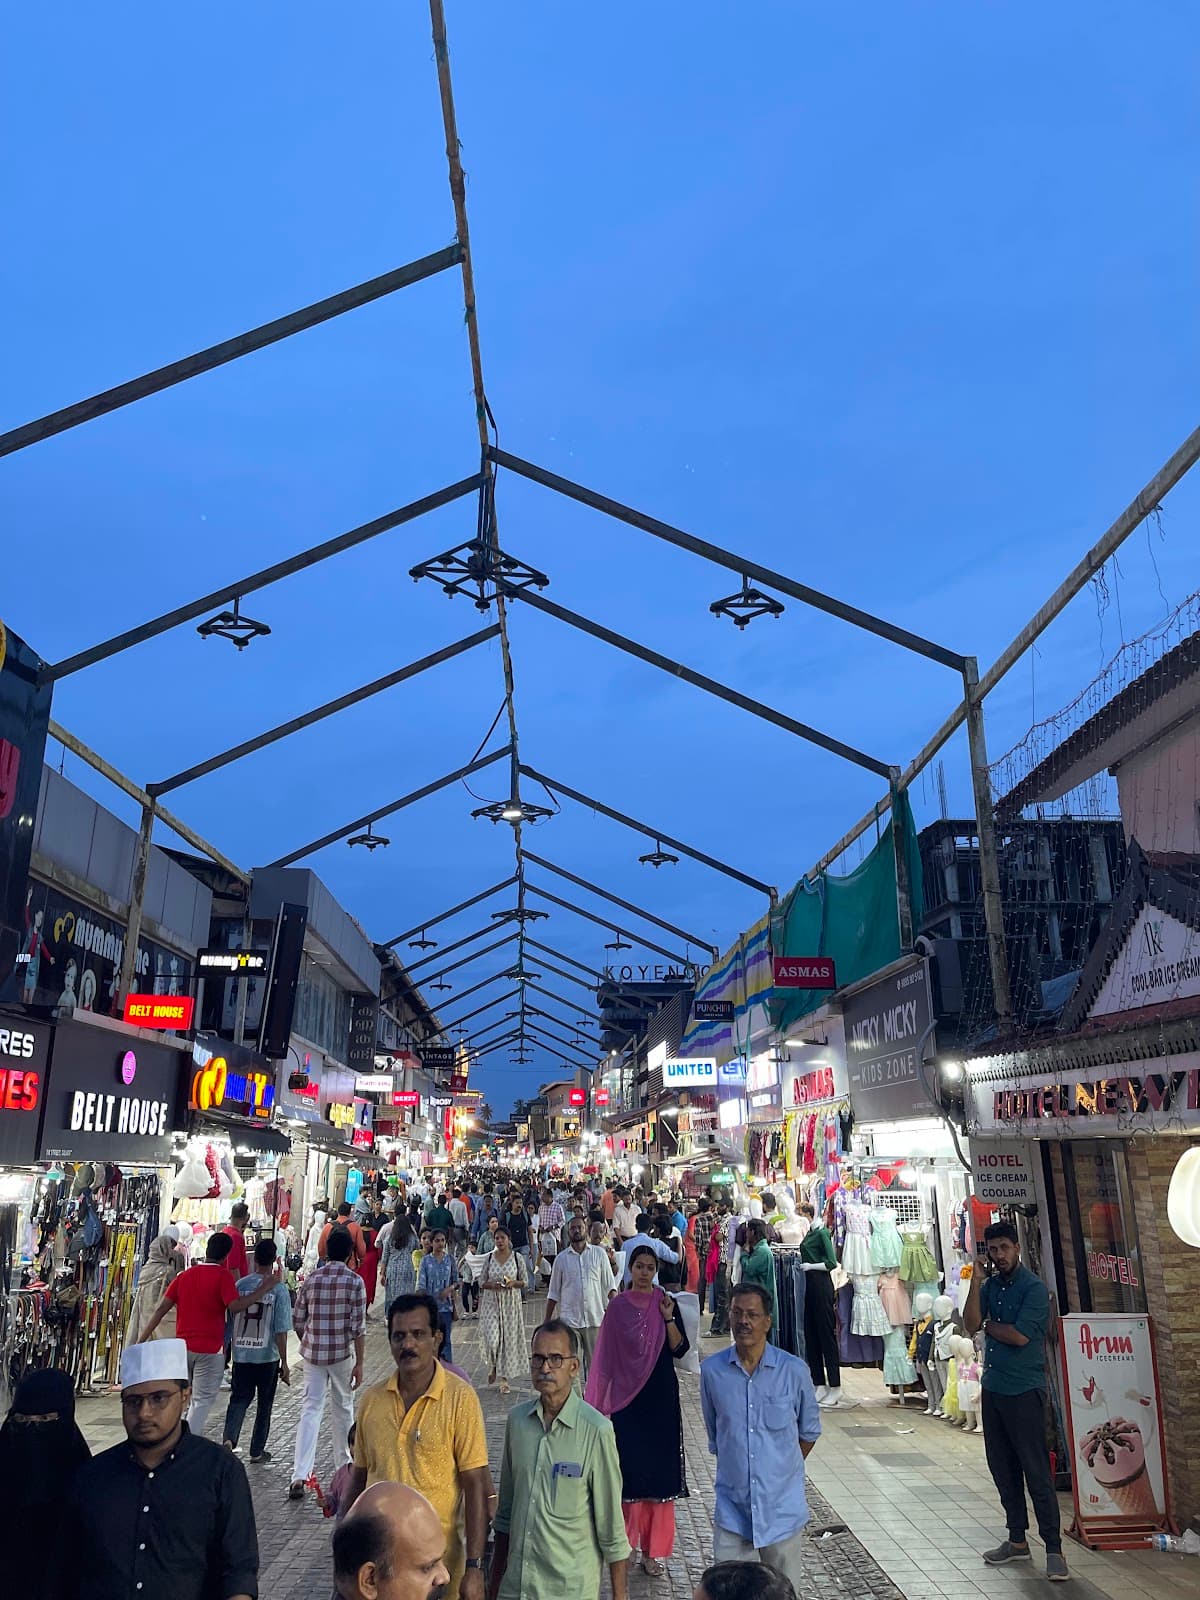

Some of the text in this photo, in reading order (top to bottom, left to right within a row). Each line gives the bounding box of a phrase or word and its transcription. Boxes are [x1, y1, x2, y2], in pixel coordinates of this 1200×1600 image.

[778, 966, 830, 977] ASMAS
[1164, 964, 1176, 985] ICE
[129, 1005, 184, 1018] BELT HOUSE
[852, 999, 917, 1053] NICKY MICKY
[668, 1063, 713, 1076] UNITED
[861, 1054, 914, 1085] KIDS ZONE
[792, 1067, 835, 1105] ASMAS
[993, 1084, 1074, 1120] HOTEL
[1074, 1071, 1186, 1115] NEW
[71, 1091, 168, 1136] BELT HOUSE
[978, 1155, 1023, 1167] HOTEL
[977, 1174, 1027, 1182] ICE CREAM
[982, 1188, 1027, 1197] COOLBAR
[1087, 1251, 1138, 1287] HOTEL
[1078, 1323, 1133, 1360] Arun
